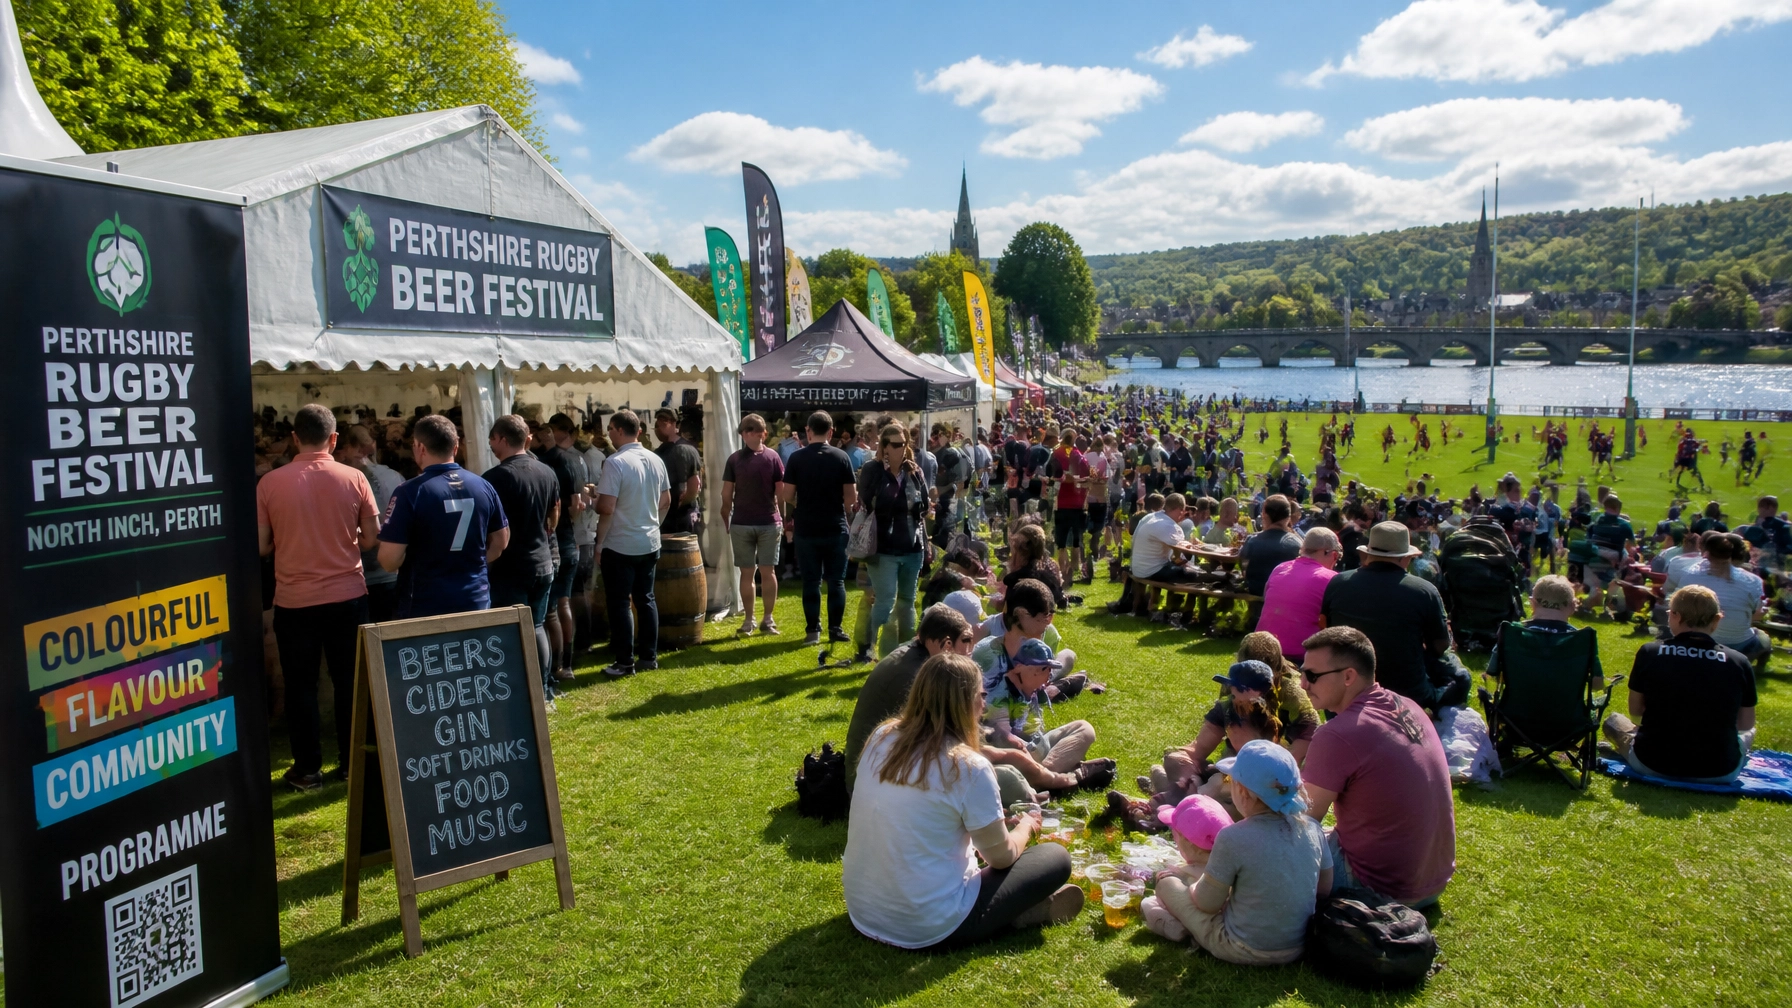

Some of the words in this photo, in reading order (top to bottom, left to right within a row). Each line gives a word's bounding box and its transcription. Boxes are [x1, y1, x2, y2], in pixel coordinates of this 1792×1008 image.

[389, 217, 532, 268] PERTHSHIRE
[537, 240, 600, 276] RUGBY
[391, 265, 476, 315] BEER
[482, 273, 604, 322] FESTIVAL
[42, 326, 194, 356] PERTHSHIRE
[45, 361, 194, 402] RUGBY
[47, 406, 196, 450] BEER
[32, 448, 213, 502] FESTIVAL
[27, 518, 101, 551] NORTH
[108, 513, 160, 540] INCH,
[165, 503, 222, 533] PERTH
[443, 498, 475, 551] 7
[39, 591, 219, 672] COLOURFUL
[398, 635, 505, 680] BEERS
[66, 658, 205, 733] FLAVOUR
[406, 672, 511, 715] CIDERS
[434, 709, 490, 746] GIN
[46, 710, 227, 810] COMMUNITY
[406, 752, 452, 782] SOFT
[459, 738, 529, 772] DRINKS
[434, 771, 509, 814] FOOD
[61, 801, 227, 901] PROGRAMME
[428, 803, 527, 856] MUSIC
